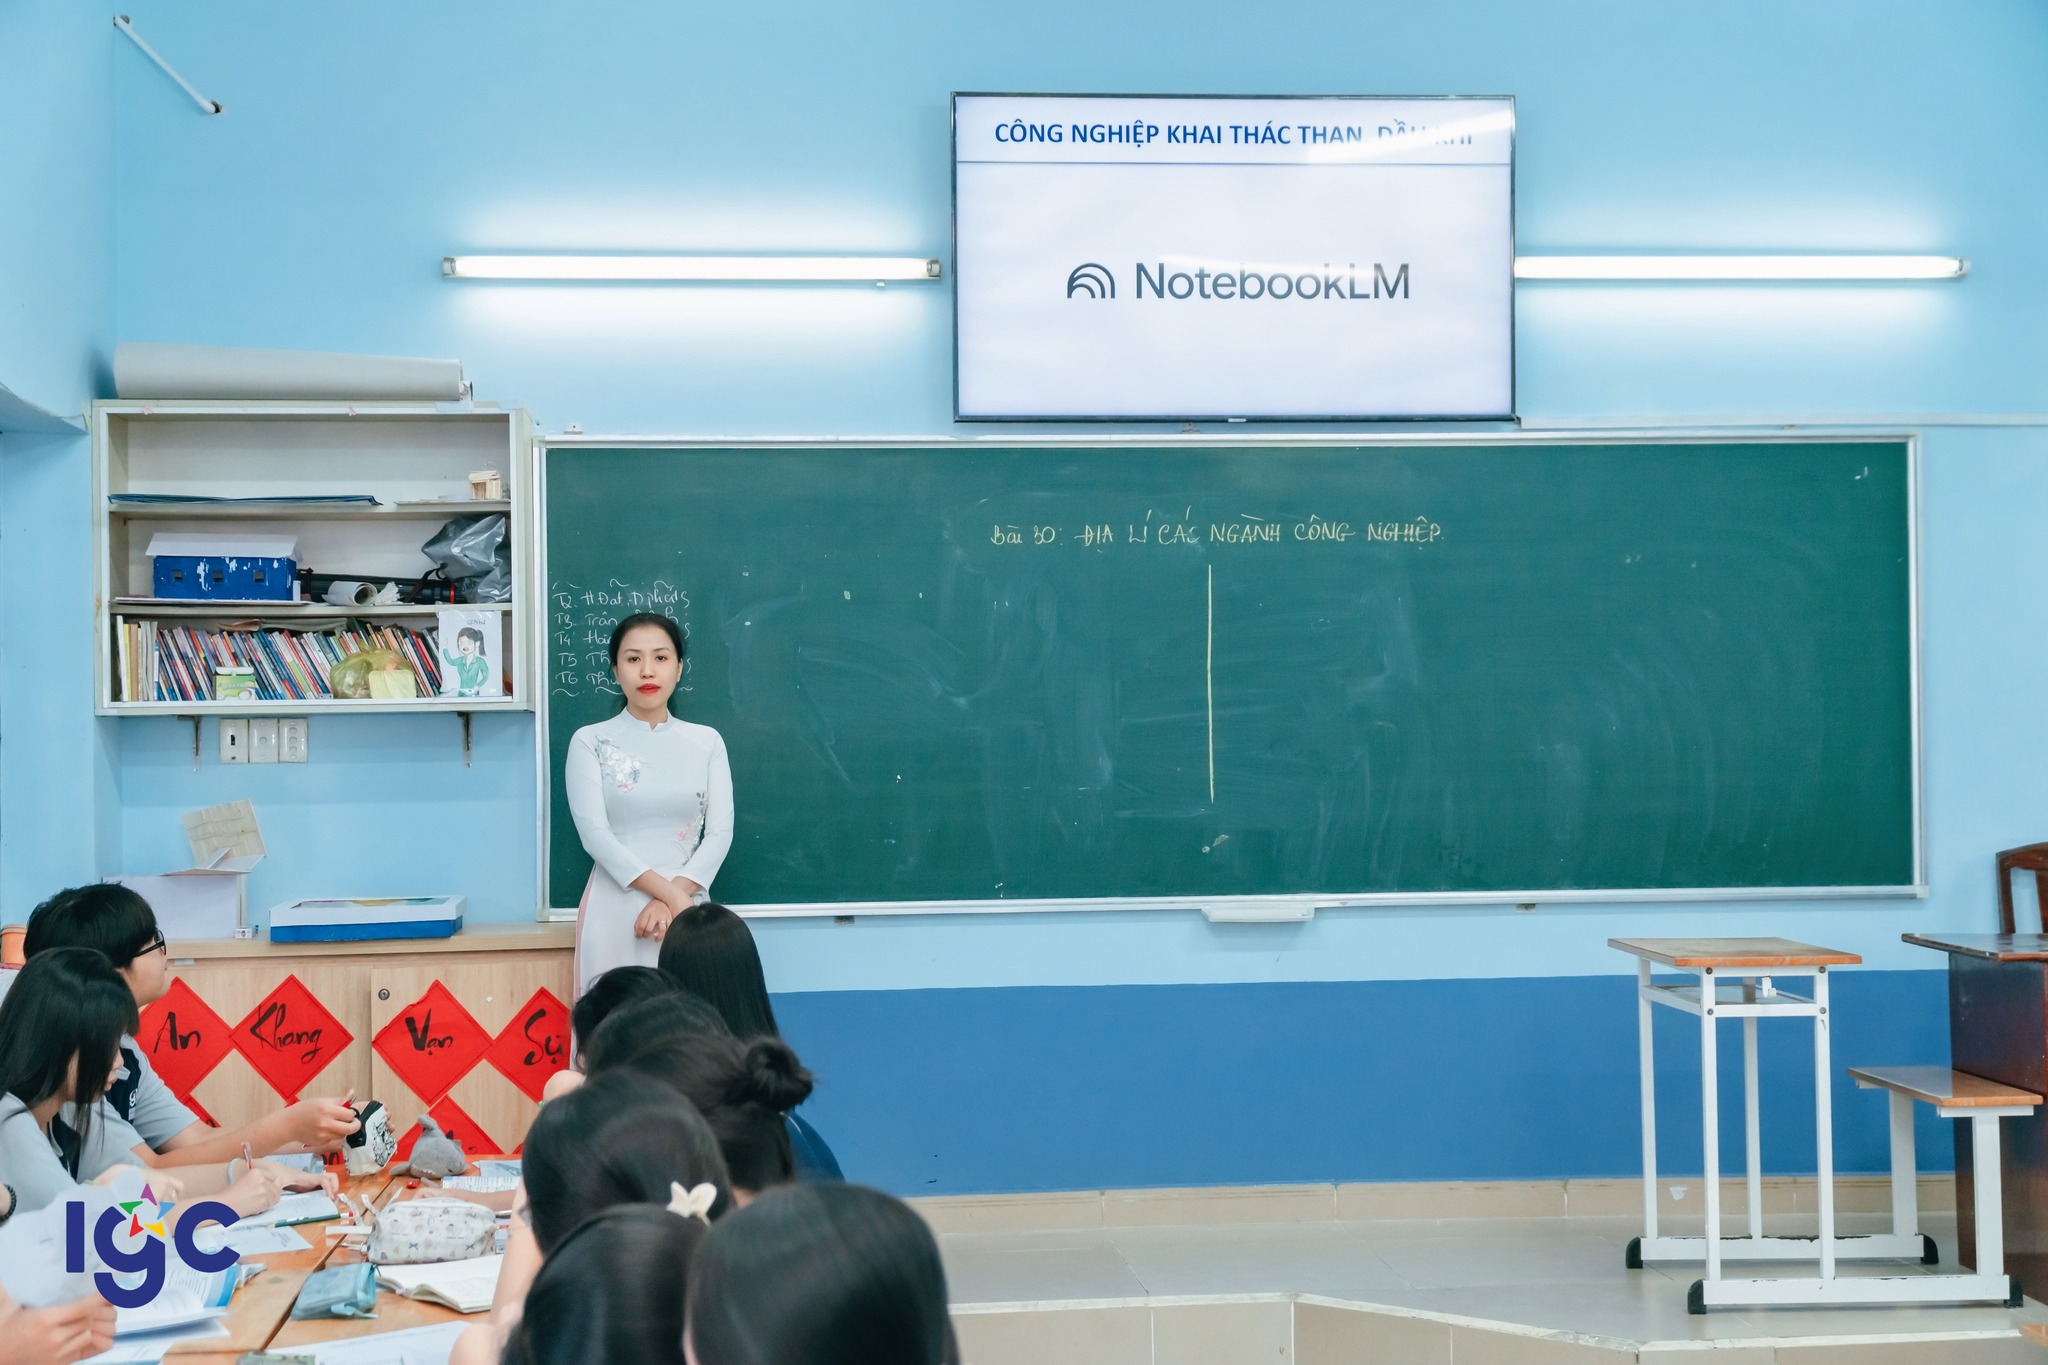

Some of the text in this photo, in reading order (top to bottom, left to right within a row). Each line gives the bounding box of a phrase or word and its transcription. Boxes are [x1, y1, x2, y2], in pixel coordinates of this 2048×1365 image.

[995, 118, 1063, 143] CÔNG
[1071, 119, 1159, 148] NGHIỆP
[1167, 125, 1222, 144] KHAI
[1229, 120, 1291, 144] THÁC
[1135, 263, 1410, 299] NotebookLM
[990, 524, 1023, 545] Bài
[1074, 524, 1115, 554] ĐỊA
[1128, 509, 1153, 543] LÍ
[1158, 505, 1201, 545] CÁC
[1210, 513, 1281, 543] NGÀNH
[1294, 514, 1356, 542] CÔNG
[555, 670, 579, 685] T6
[557, 652, 578, 667] T5
[153, 1010, 201, 1054] An
[249, 1001, 323, 1065] Khang
[405, 1008, 454, 1056] Vạn
